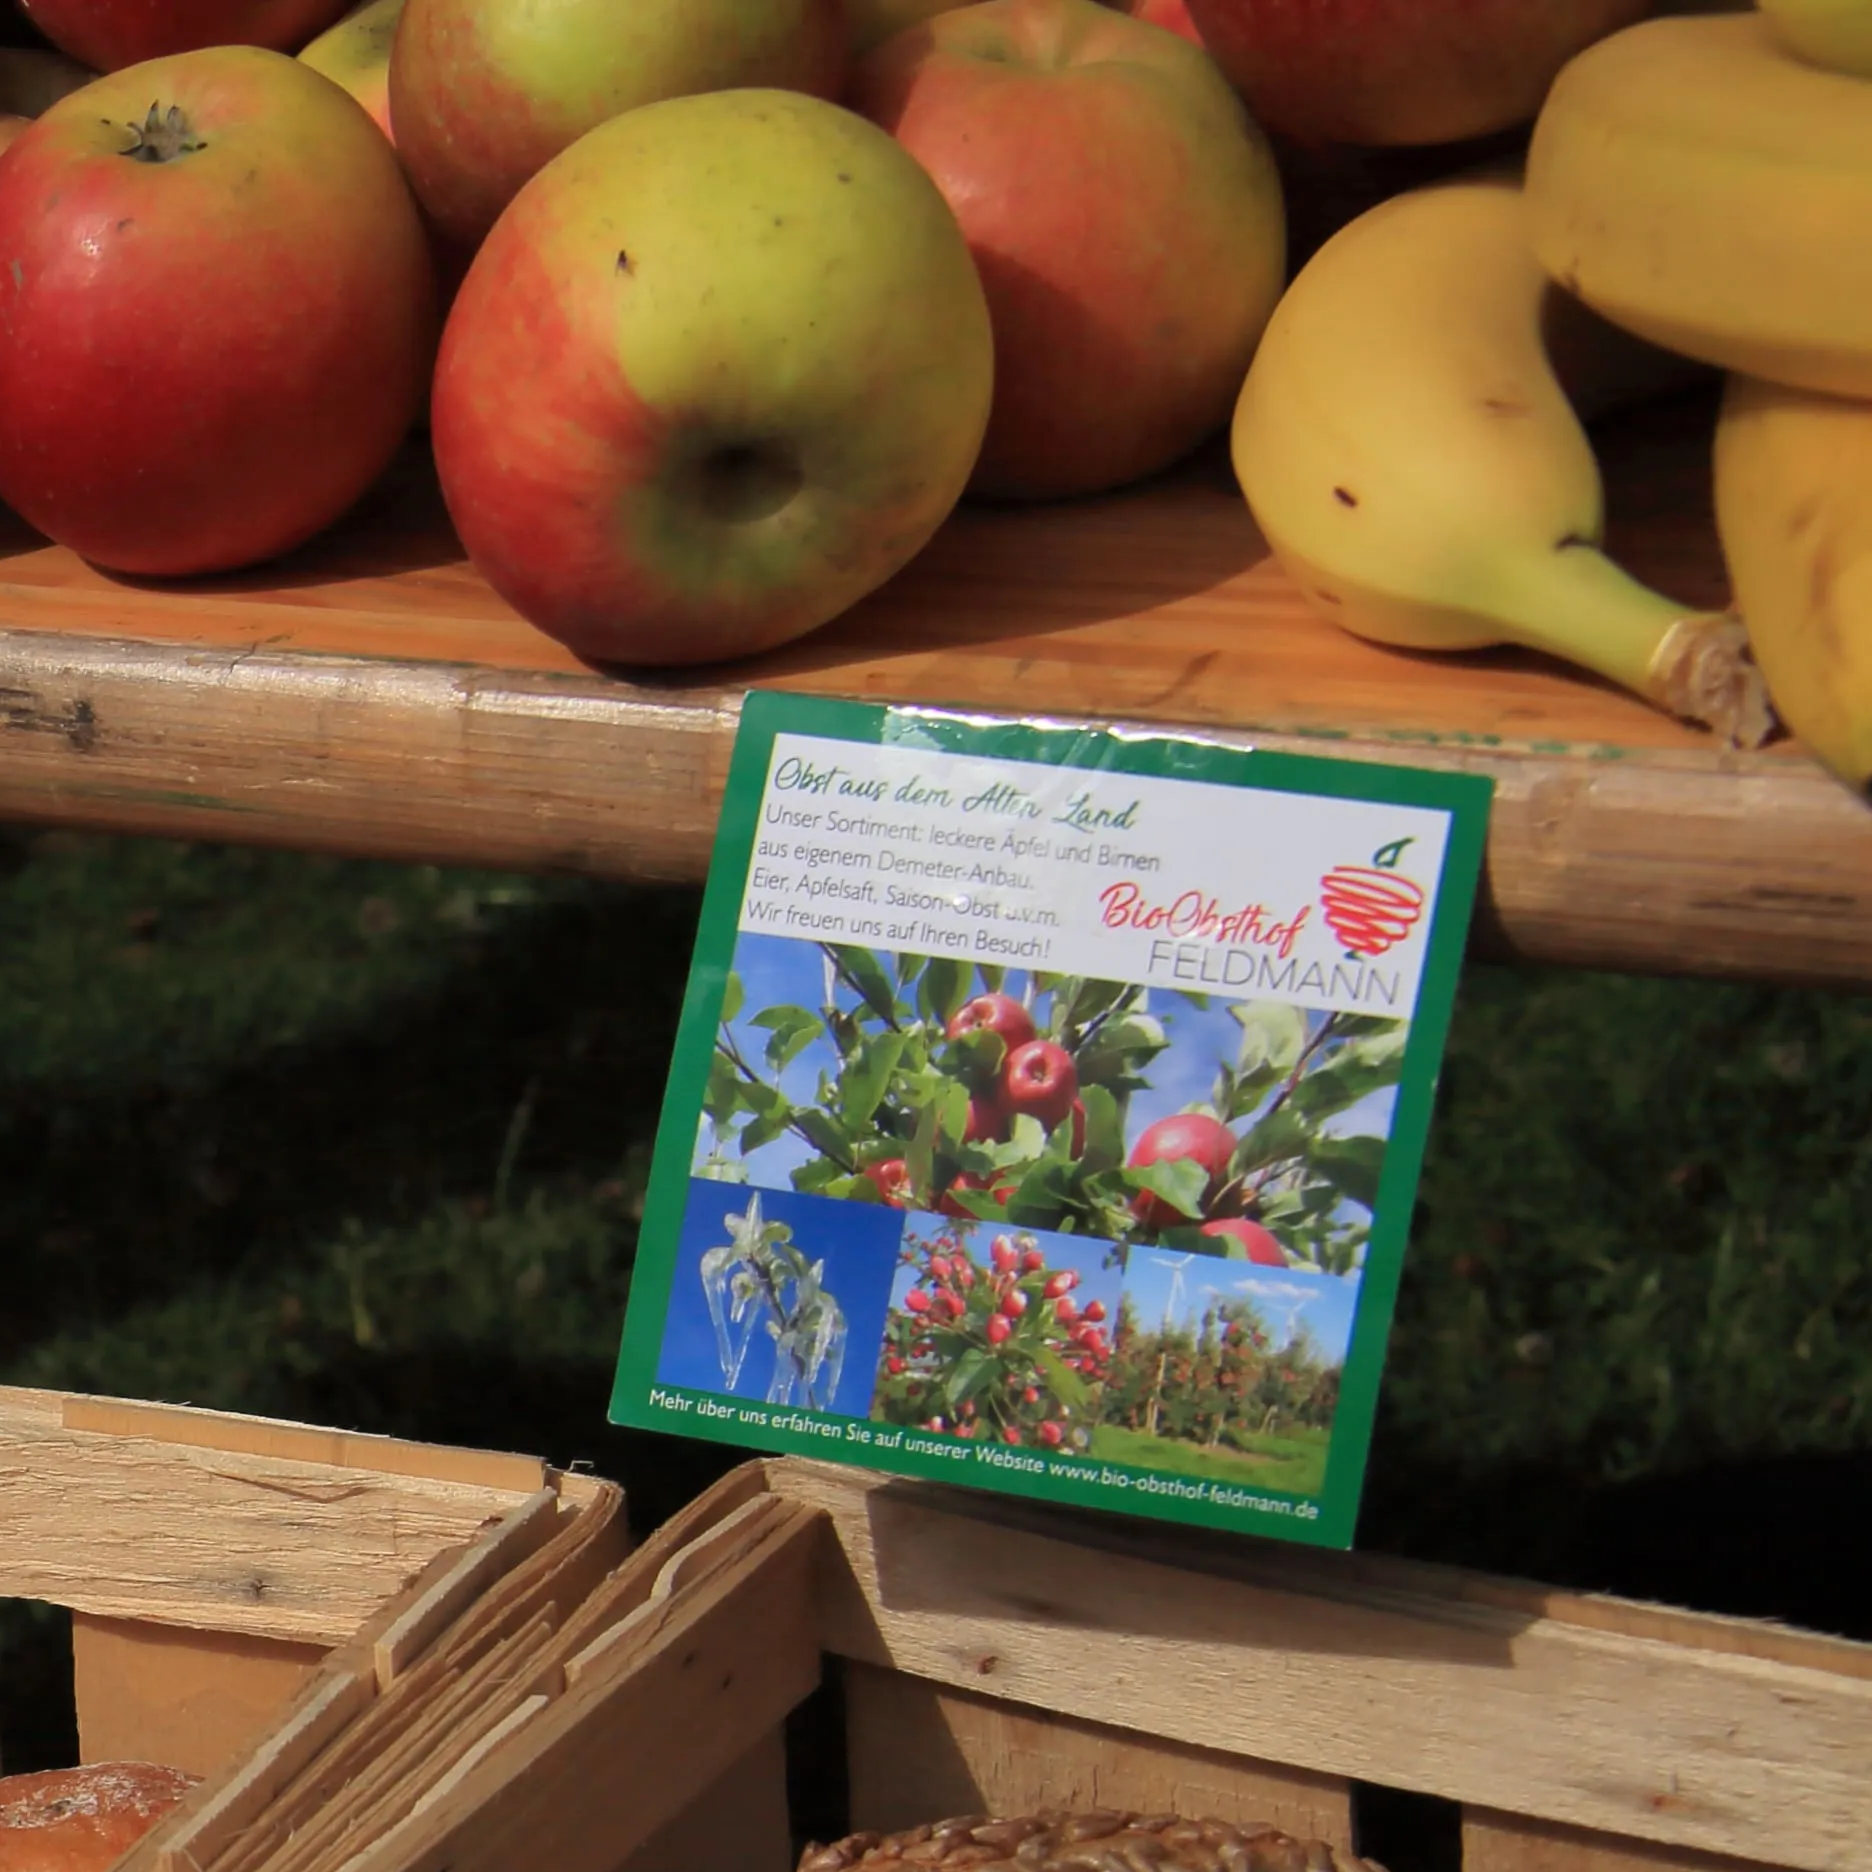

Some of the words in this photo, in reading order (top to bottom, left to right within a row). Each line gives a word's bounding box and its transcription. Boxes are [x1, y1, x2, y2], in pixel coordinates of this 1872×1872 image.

[774, 758, 845, 793] Obst
[839, 777, 886, 803] aus
[896, 779, 953, 809] dem
[962, 782, 1042, 819] Alten
[1053, 792, 1139, 835] Land
[757, 840, 789, 858] aus
[793, 844, 872, 870] eigenem
[877, 850, 1035, 891] Demeter-Anbau.
[765, 804, 823, 829] Unser
[826, 810, 924, 844] Sortiment:
[930, 823, 996, 852] leckere
[1001, 828, 1050, 864] Äpfel
[1056, 842, 1091, 865] und
[1098, 847, 1161, 873] Birnen
[753, 868, 790, 893] Eier,
[886, 885, 999, 921] Saison-Obst
[1099, 882, 1311, 959] BioObsthof
[747, 900, 782, 922] Wir
[785, 905, 845, 932] freuen
[850, 917, 881, 936] uns
[887, 917, 917, 941] auf
[920, 922, 969, 948] Ihren
[974, 928, 1051, 959] Besuch!
[1148, 940, 1401, 1005] FELDMANN
[649, 1389, 694, 1413] Mehr
[696, 1396, 736, 1420] über
[739, 1407, 768, 1425] uns
[771, 1409, 843, 1440] erfahren
[845, 1420, 871, 1444] Sie
[874, 1425, 902, 1449] auf
[905, 1435, 971, 1461] unserer
[975, 1444, 1045, 1474] Website
[1049, 1460, 1320, 1521] www.bio-obsthof-feldmann.de
